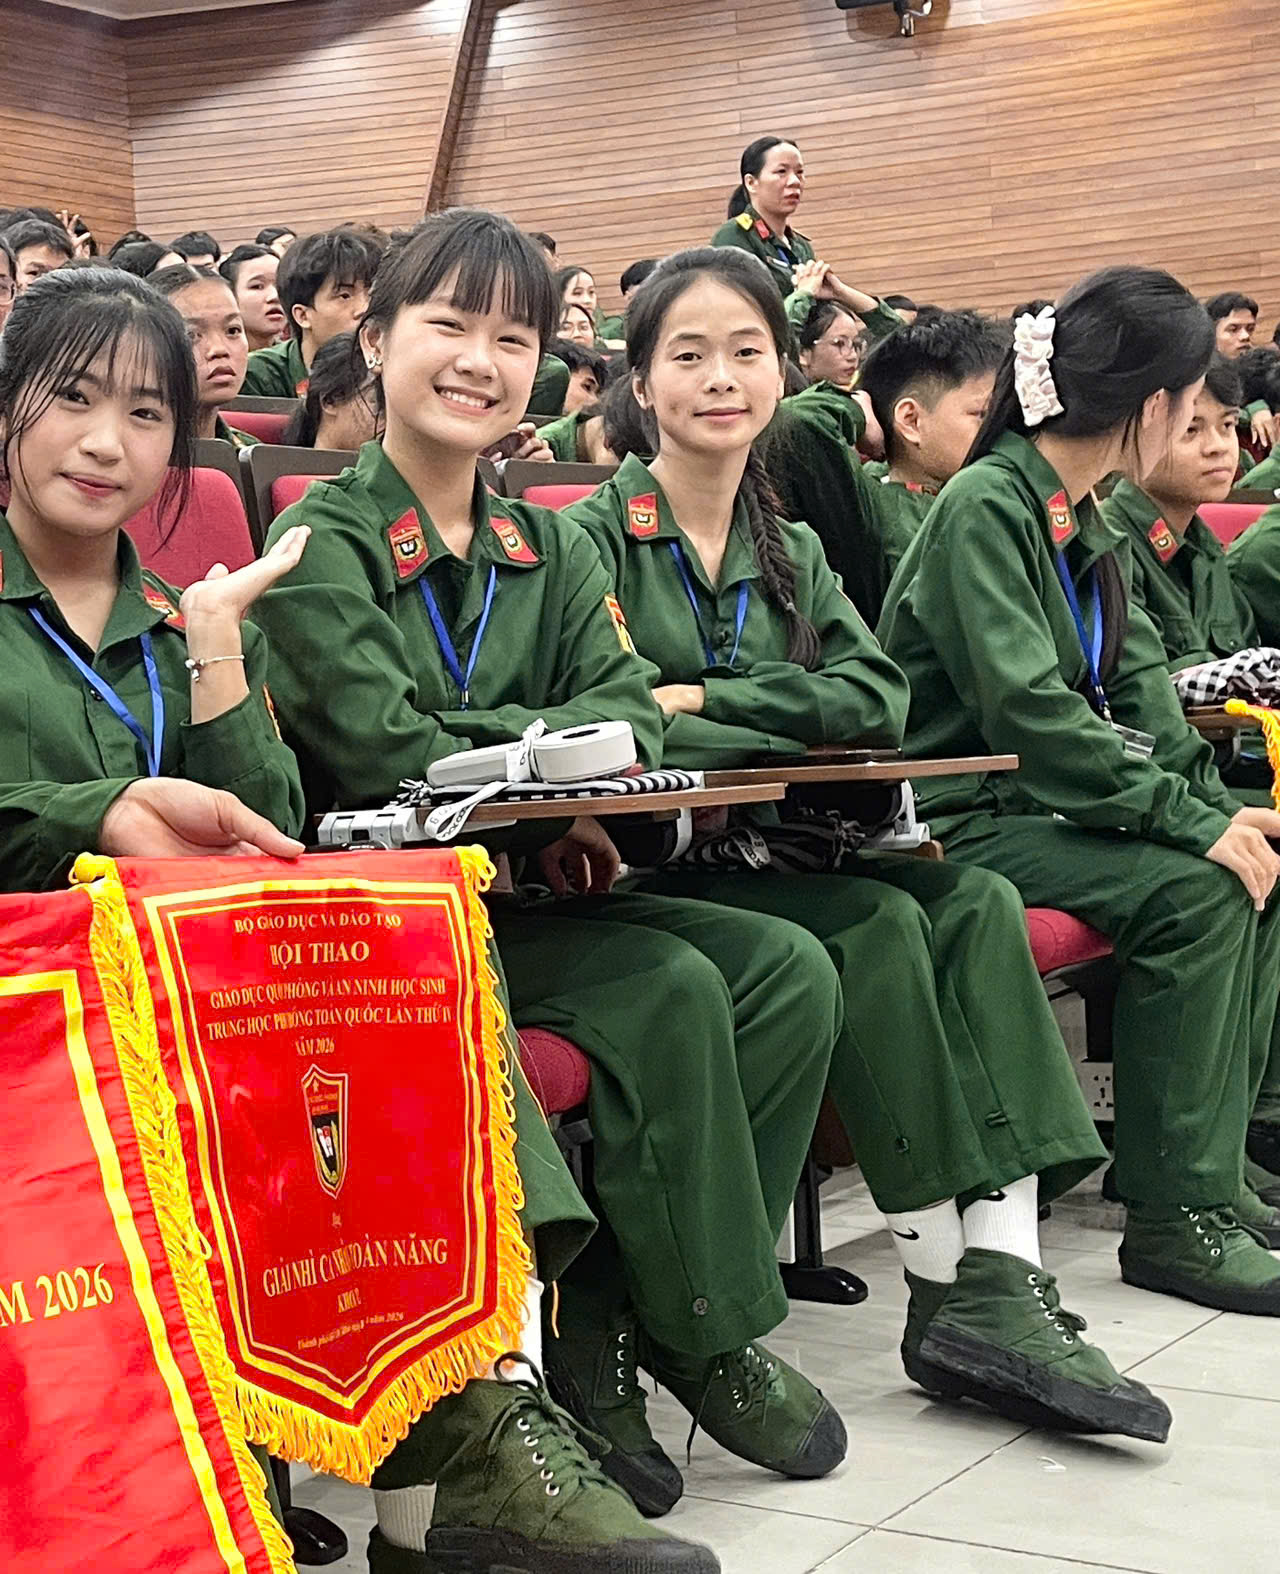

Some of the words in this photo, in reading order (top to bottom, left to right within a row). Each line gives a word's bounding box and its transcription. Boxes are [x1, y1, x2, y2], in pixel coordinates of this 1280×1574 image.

[287, 914, 318, 931] DỤC
[308, 941, 370, 963] THAO
[353, 978, 387, 996] NINH
[390, 977, 418, 999] HỌC
[420, 977, 446, 995] SINH
[247, 1014, 272, 1037] HỌC
[344, 1001, 384, 1028] QUỐC
[393, 1231, 449, 1268] NĂNG
[36, 1263, 113, 1318] 2026
